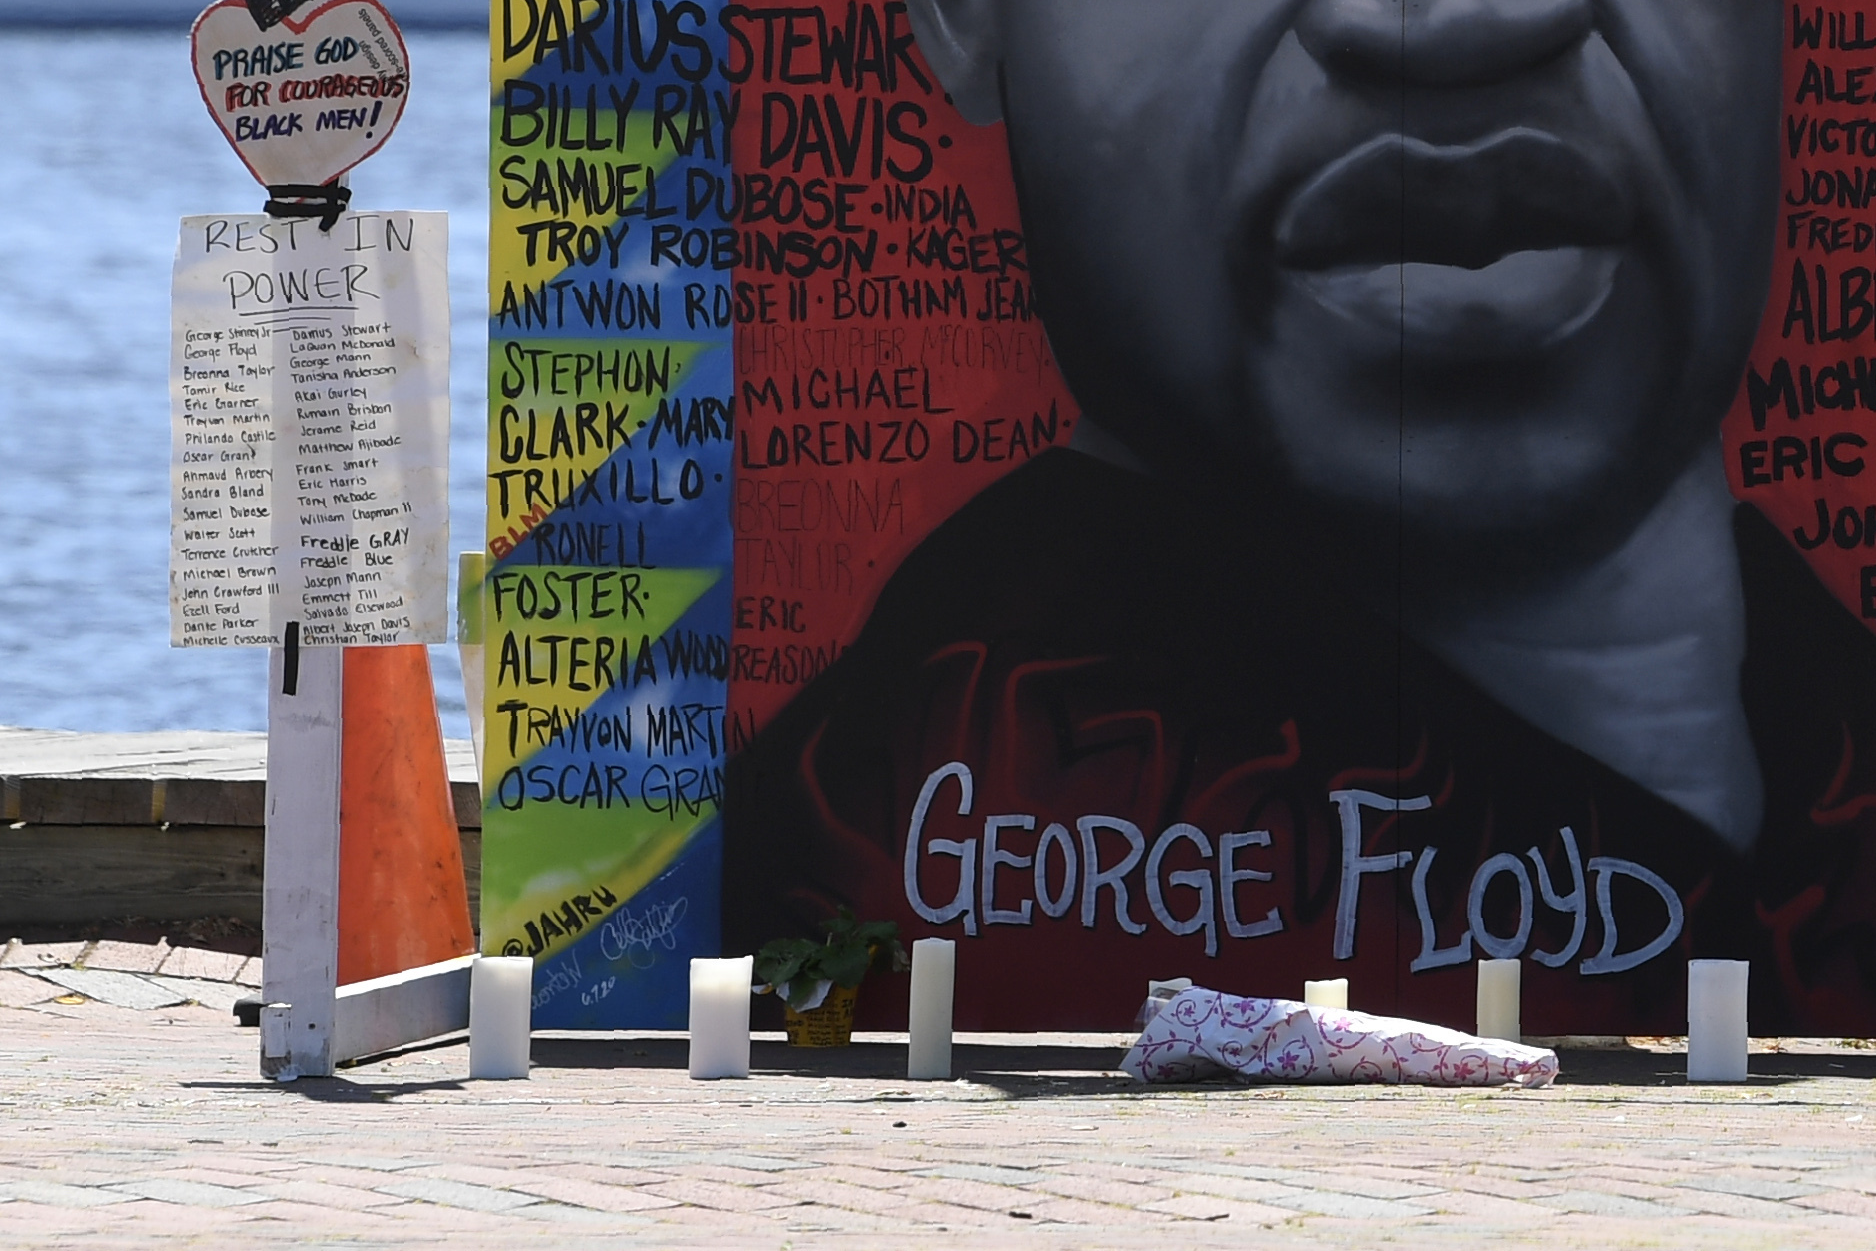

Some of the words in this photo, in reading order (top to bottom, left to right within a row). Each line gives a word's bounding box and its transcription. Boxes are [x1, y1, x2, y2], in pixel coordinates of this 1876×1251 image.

[358, 8, 381, 37] panels
[213, 41, 304, 80] PRAISE
[314, 36, 360, 64] GOD
[359, 40, 380, 69] design
[225, 81, 271, 112] FOR
[235, 111, 302, 142] BLACK
[316, 101, 383, 138] MEN!
[500, 79, 639, 151] BILLY
[652, 83, 742, 165] RAY
[500, 155, 677, 220] SAMUEL
[686, 166, 868, 233] DUBOSE
[884, 183, 976, 229] INDIA
[205, 218, 308, 253] REST
[344, 214, 414, 252] IN
[517, 218, 630, 269] TROY
[651, 225, 881, 277] ROBINSON
[906, 226, 1029, 273] KAGER
[222, 264, 380, 309] POWER
[499, 280, 660, 330] ANTWON
[685, 279, 779, 330] ROSE
[834, 276, 965, 321] BOTHAM
[186, 330, 224, 343] George
[342, 322, 391, 337] Stewart
[342, 338, 395, 349] McDonald
[185, 344, 221, 362] George
[228, 343, 257, 360] Floyd
[290, 357, 330, 369] George
[336, 354, 371, 362] Mann
[740, 324, 905, 375] CHRISTOPHER
[183, 385, 216, 395] Tamir
[225, 382, 245, 393] Rice
[184, 366, 230, 380] Breonna
[238, 365, 275, 379] Taylor
[291, 369, 338, 384] Tanisha
[344, 366, 396, 378] Anderson
[500, 341, 670, 399] STEPHON
[185, 399, 207, 410] Eric
[216, 398, 259, 410] Garner
[295, 389, 321, 403] Akai
[328, 388, 367, 399] Gurley
[348, 403, 391, 415] Brisbon
[742, 367, 955, 417] MICHAEL
[233, 414, 270, 424] Martin
[500, 401, 631, 464] CLARK
[648, 395, 735, 446] MARY
[740, 418, 930, 469] LORENZO
[953, 398, 1058, 463] DEAN
[185, 433, 233, 445] Philando
[241, 431, 276, 443] Castile
[296, 463, 333, 475] Frank
[343, 458, 378, 471] Smart
[1739, 431, 1868, 487] ERIC
[182, 487, 220, 500] Sandra
[230, 484, 264, 499] Bland
[299, 480, 323, 490] Eric
[330, 476, 367, 487] Harris
[488, 458, 704, 517] TRUXILLO
[300, 513, 344, 525] William
[353, 507, 399, 521] Chapman
[738, 477, 902, 535] BREONNA
[301, 534, 359, 552] Freddie
[370, 527, 409, 548] GRAY
[488, 503, 548, 559] BLM
[534, 520, 656, 569] RONELL
[184, 569, 230, 581] Michael
[238, 567, 276, 578] Brown
[738, 538, 853, 594] TAYLOR
[183, 604, 210, 617] Ezell
[216, 603, 239, 615] Ford
[303, 593, 351, 605] Emmett
[358, 589, 378, 599] Till
[494, 572, 644, 622] FOSTER
[735, 596, 806, 633] ERIC
[498, 630, 657, 691] ALTERIA
[497, 700, 632, 756] TRAYVON
[647, 702, 755, 757] MARTIN
[499, 762, 629, 812] OSCAR
[903, 761, 1284, 957] GEORGE
[1328, 788, 1684, 975] FLOYD
